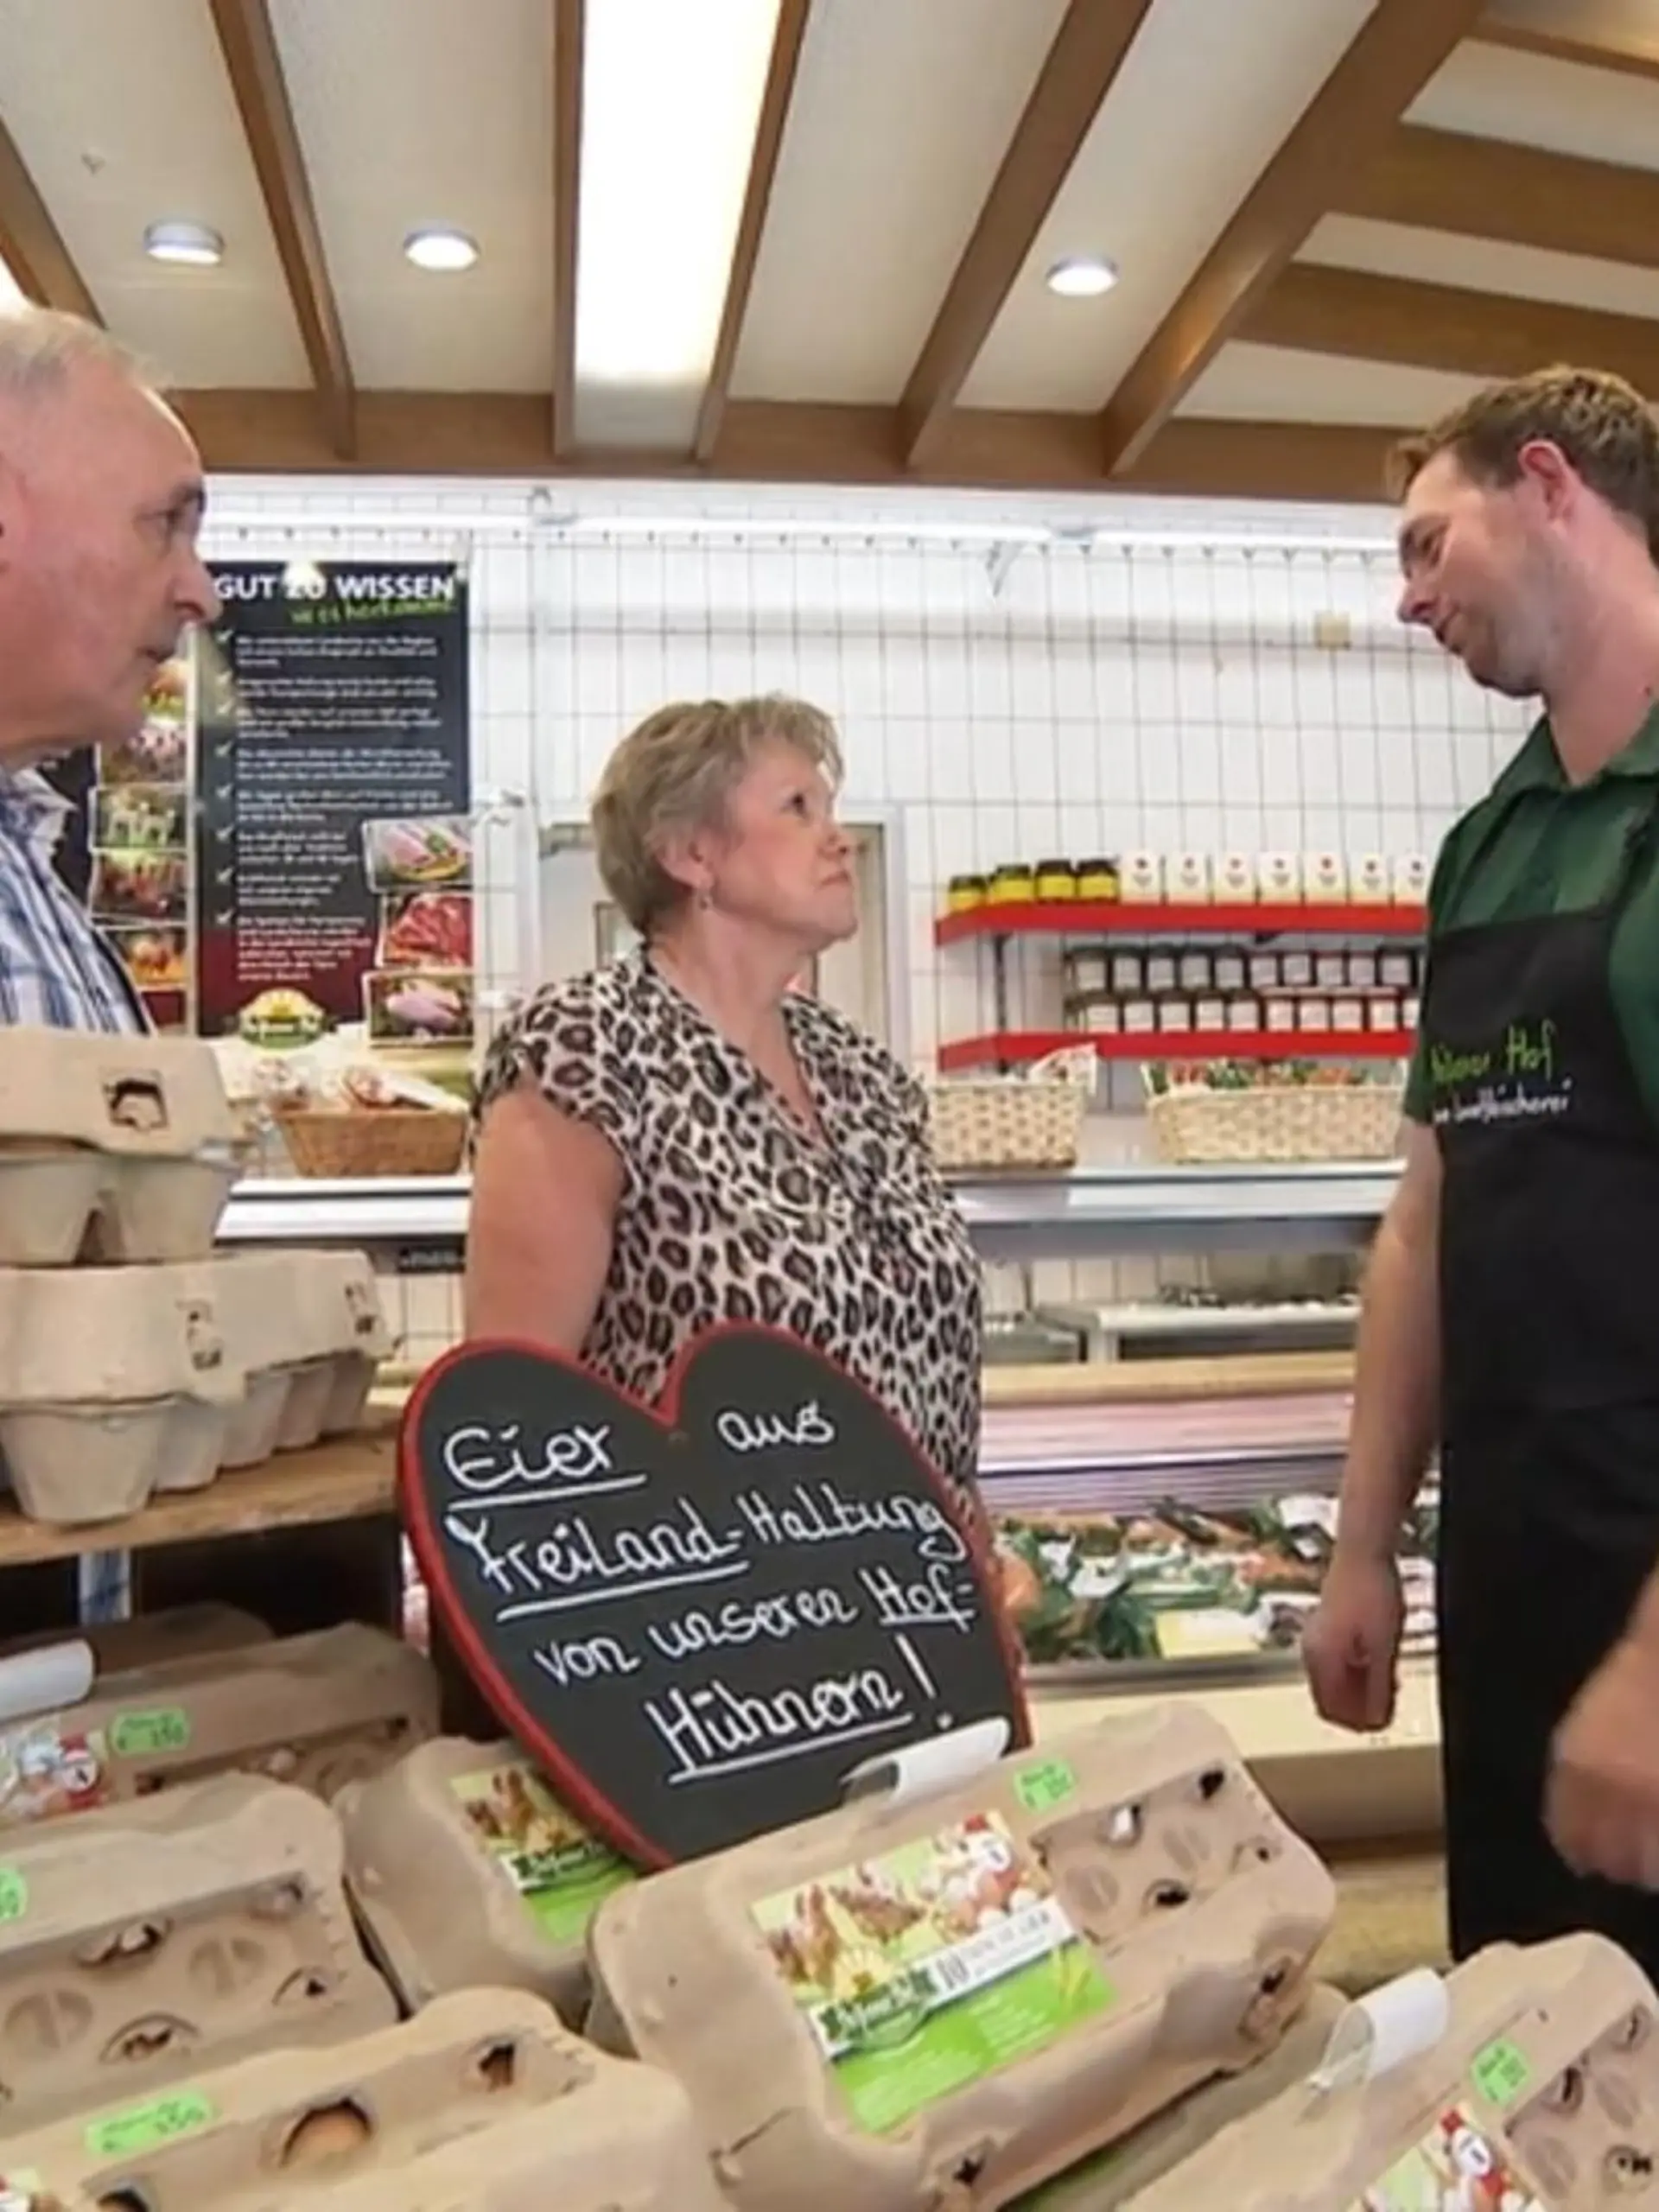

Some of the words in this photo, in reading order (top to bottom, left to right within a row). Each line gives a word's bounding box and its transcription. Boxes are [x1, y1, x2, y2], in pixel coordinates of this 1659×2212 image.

[215, 573, 277, 600] GUT
[335, 573, 454, 600] WISSEN
[443, 1424, 611, 1490] Eier
[717, 1400, 836, 1452] aus
[533, 1637, 641, 1687] von
[648, 1586, 858, 1659] unseren
